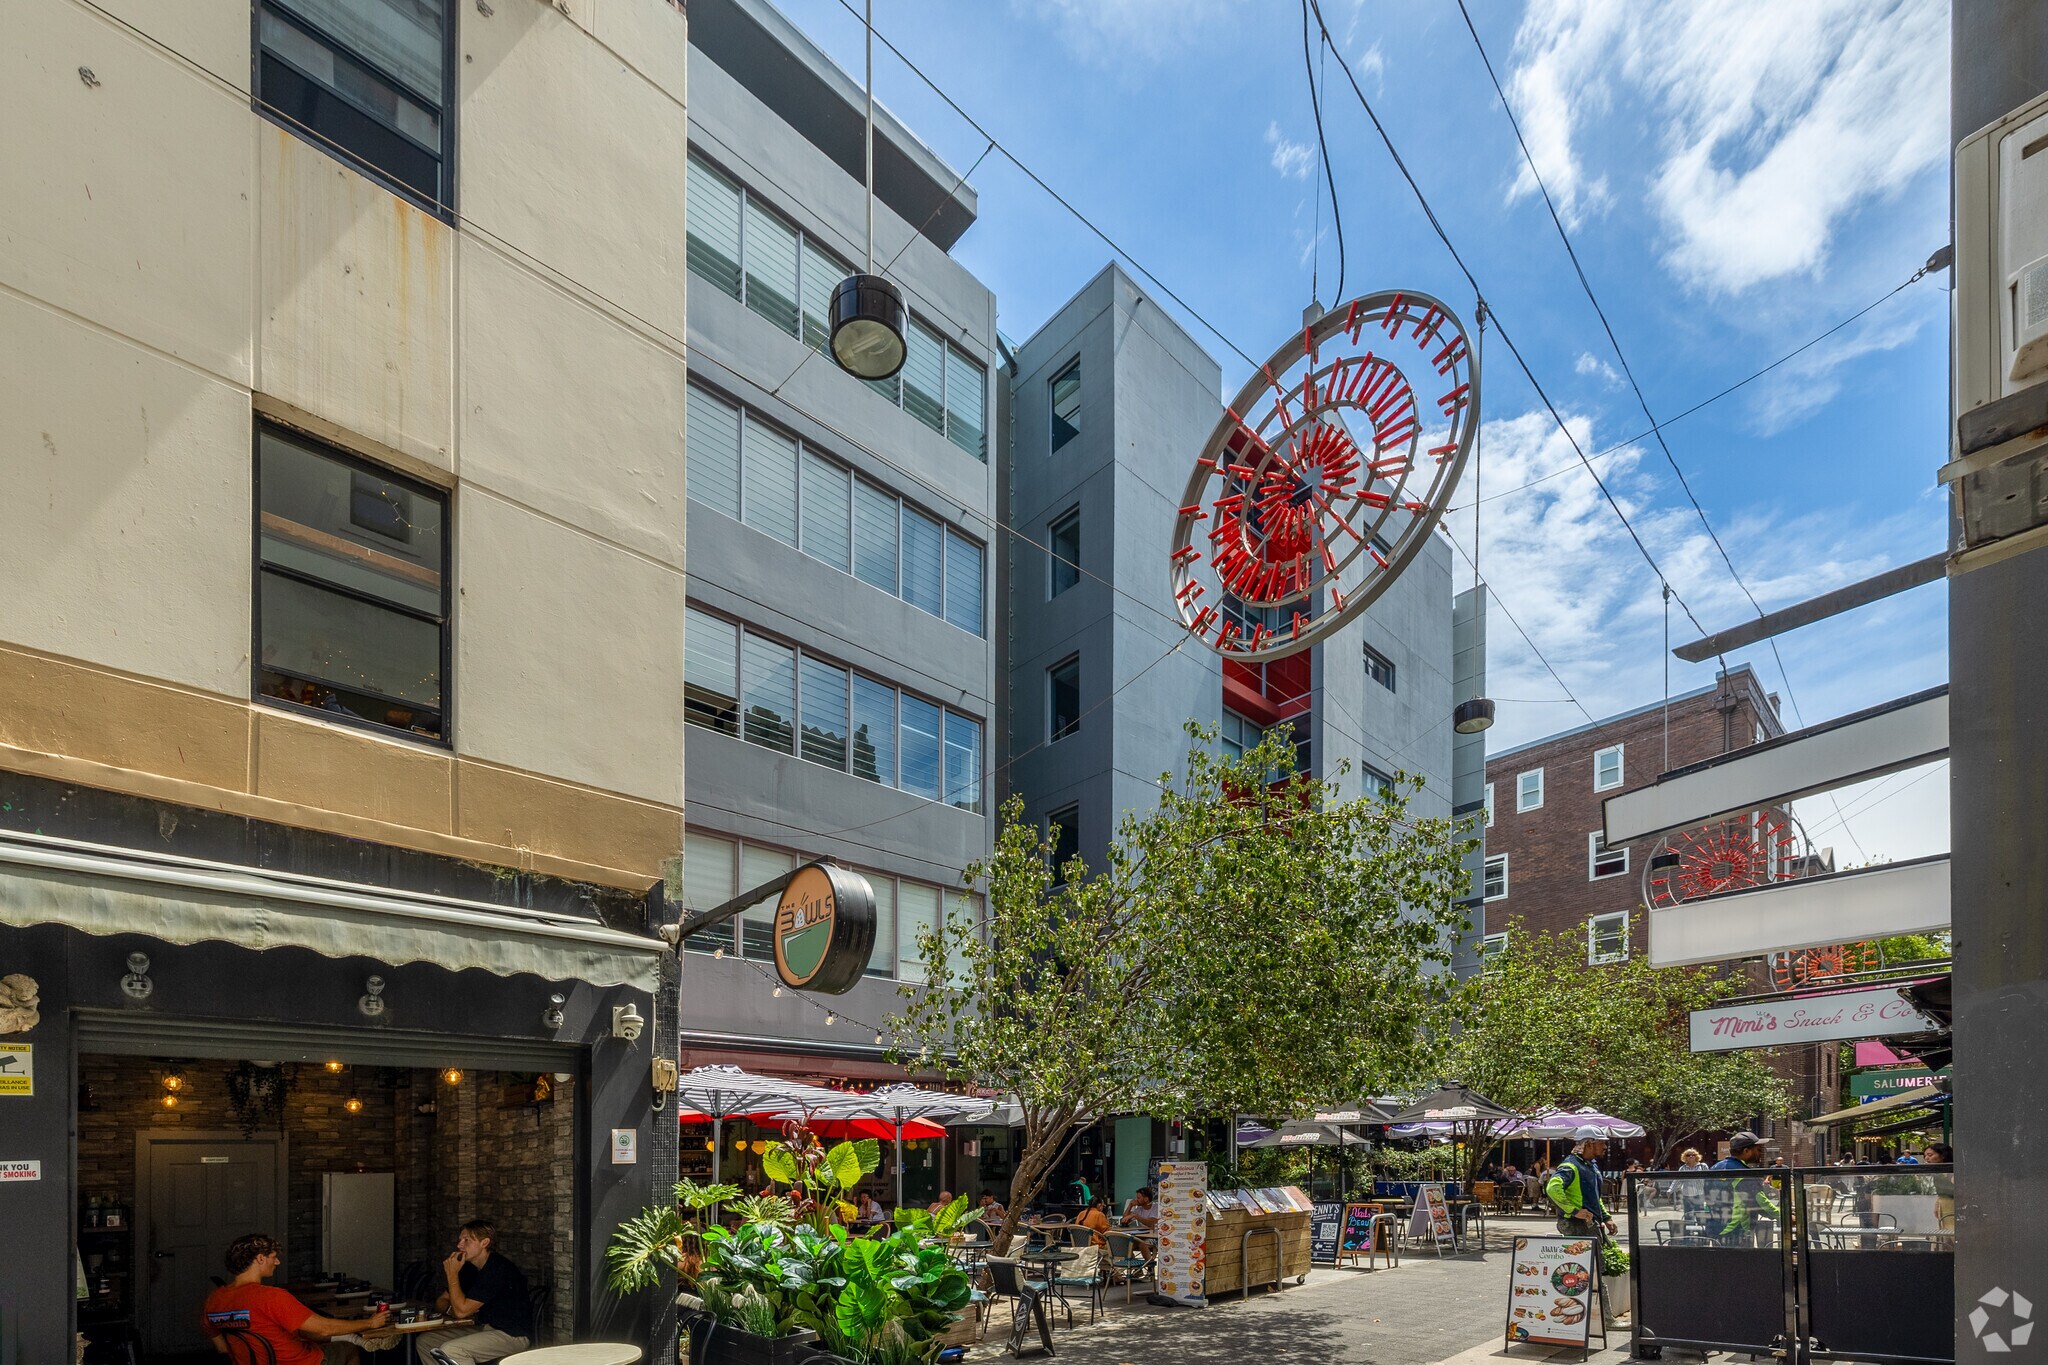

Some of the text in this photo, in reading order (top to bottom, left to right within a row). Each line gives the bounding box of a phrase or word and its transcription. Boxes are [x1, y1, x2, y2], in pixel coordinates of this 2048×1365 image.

[1710, 1016, 1776, 1037] Mimi's
[1784, 1009, 1844, 1028] Snack
[1852, 1003, 1874, 1022] &
[1873, 1075, 1947, 1089] SALUMER
[11, 1163, 29, 1171] YOU
